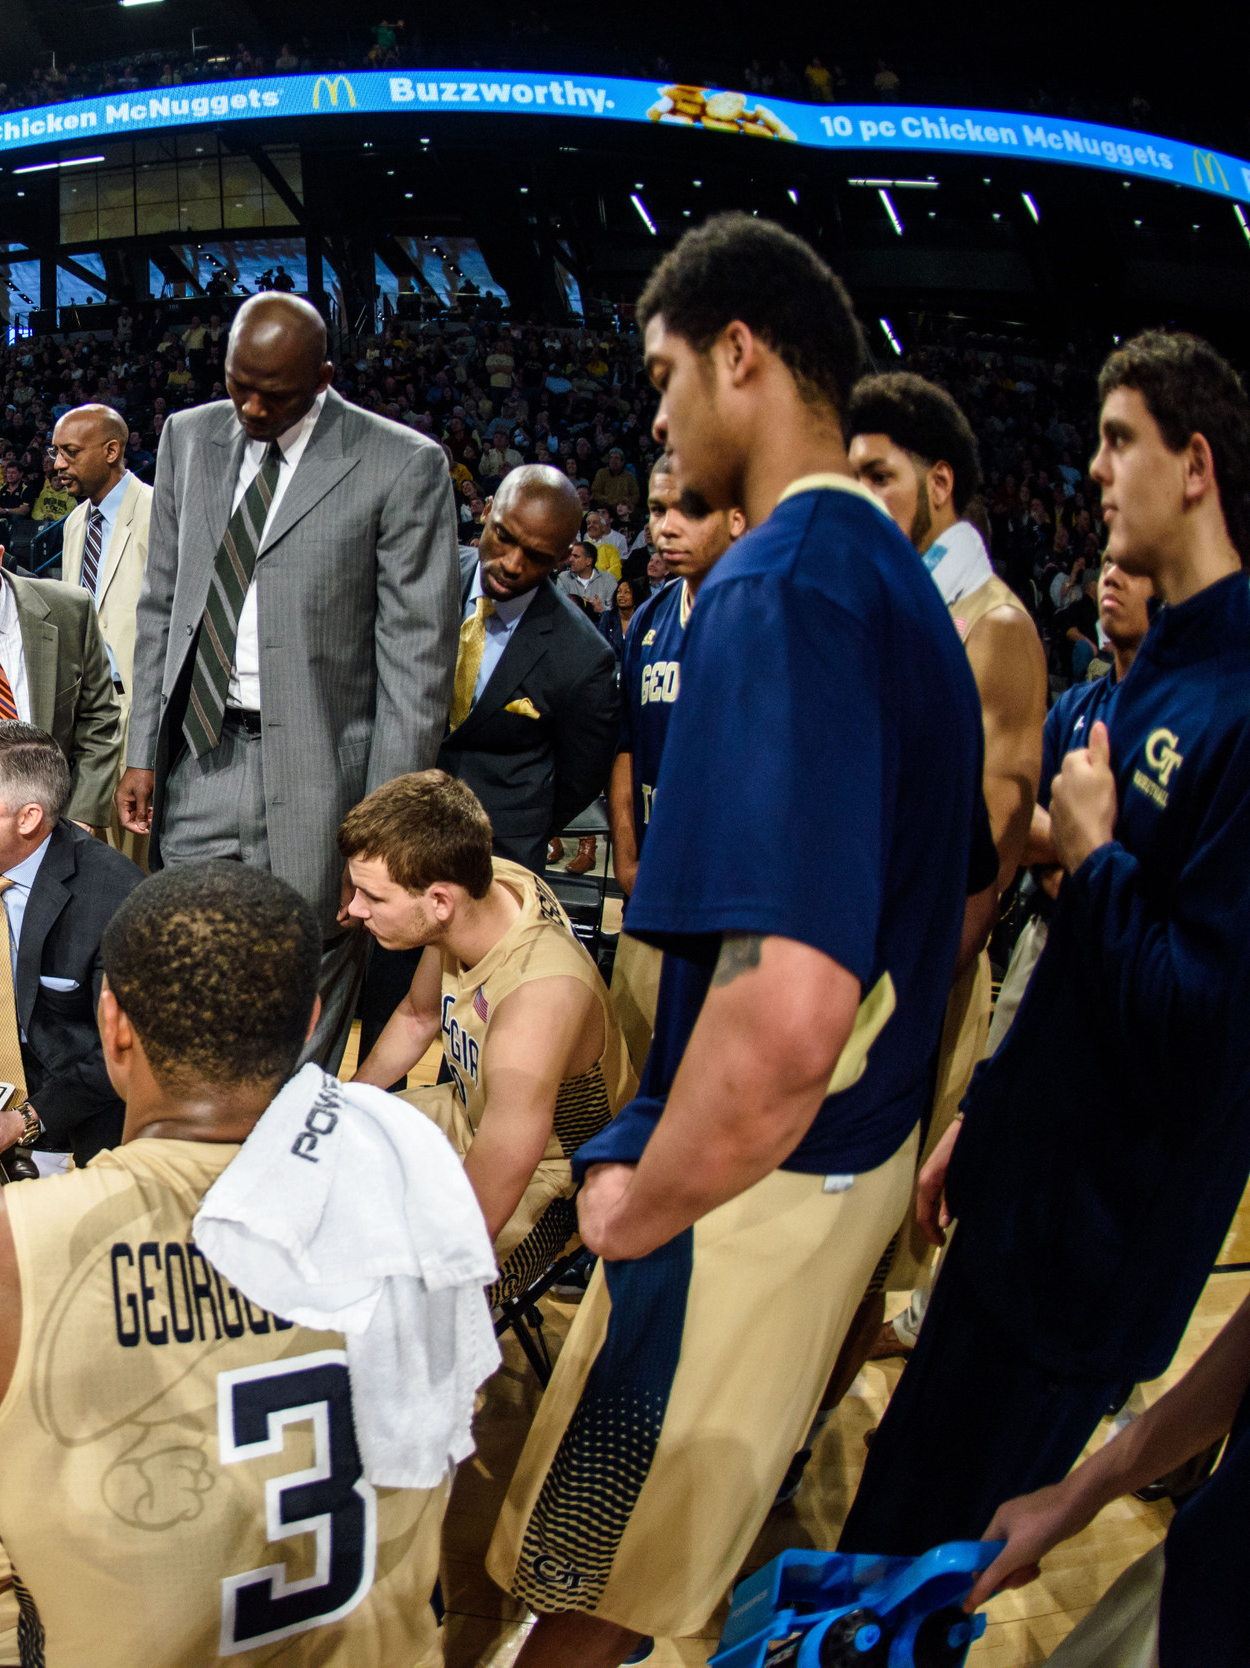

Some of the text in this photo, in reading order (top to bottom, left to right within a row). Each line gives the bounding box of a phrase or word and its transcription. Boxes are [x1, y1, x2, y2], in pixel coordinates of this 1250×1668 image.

[389, 77, 615, 113] Buzzworthy.
[820, 115, 853, 138] 10
[859, 117, 896, 142] pc
[901, 116, 1019, 146] Chicken
[217, 1348, 378, 1658] 3
